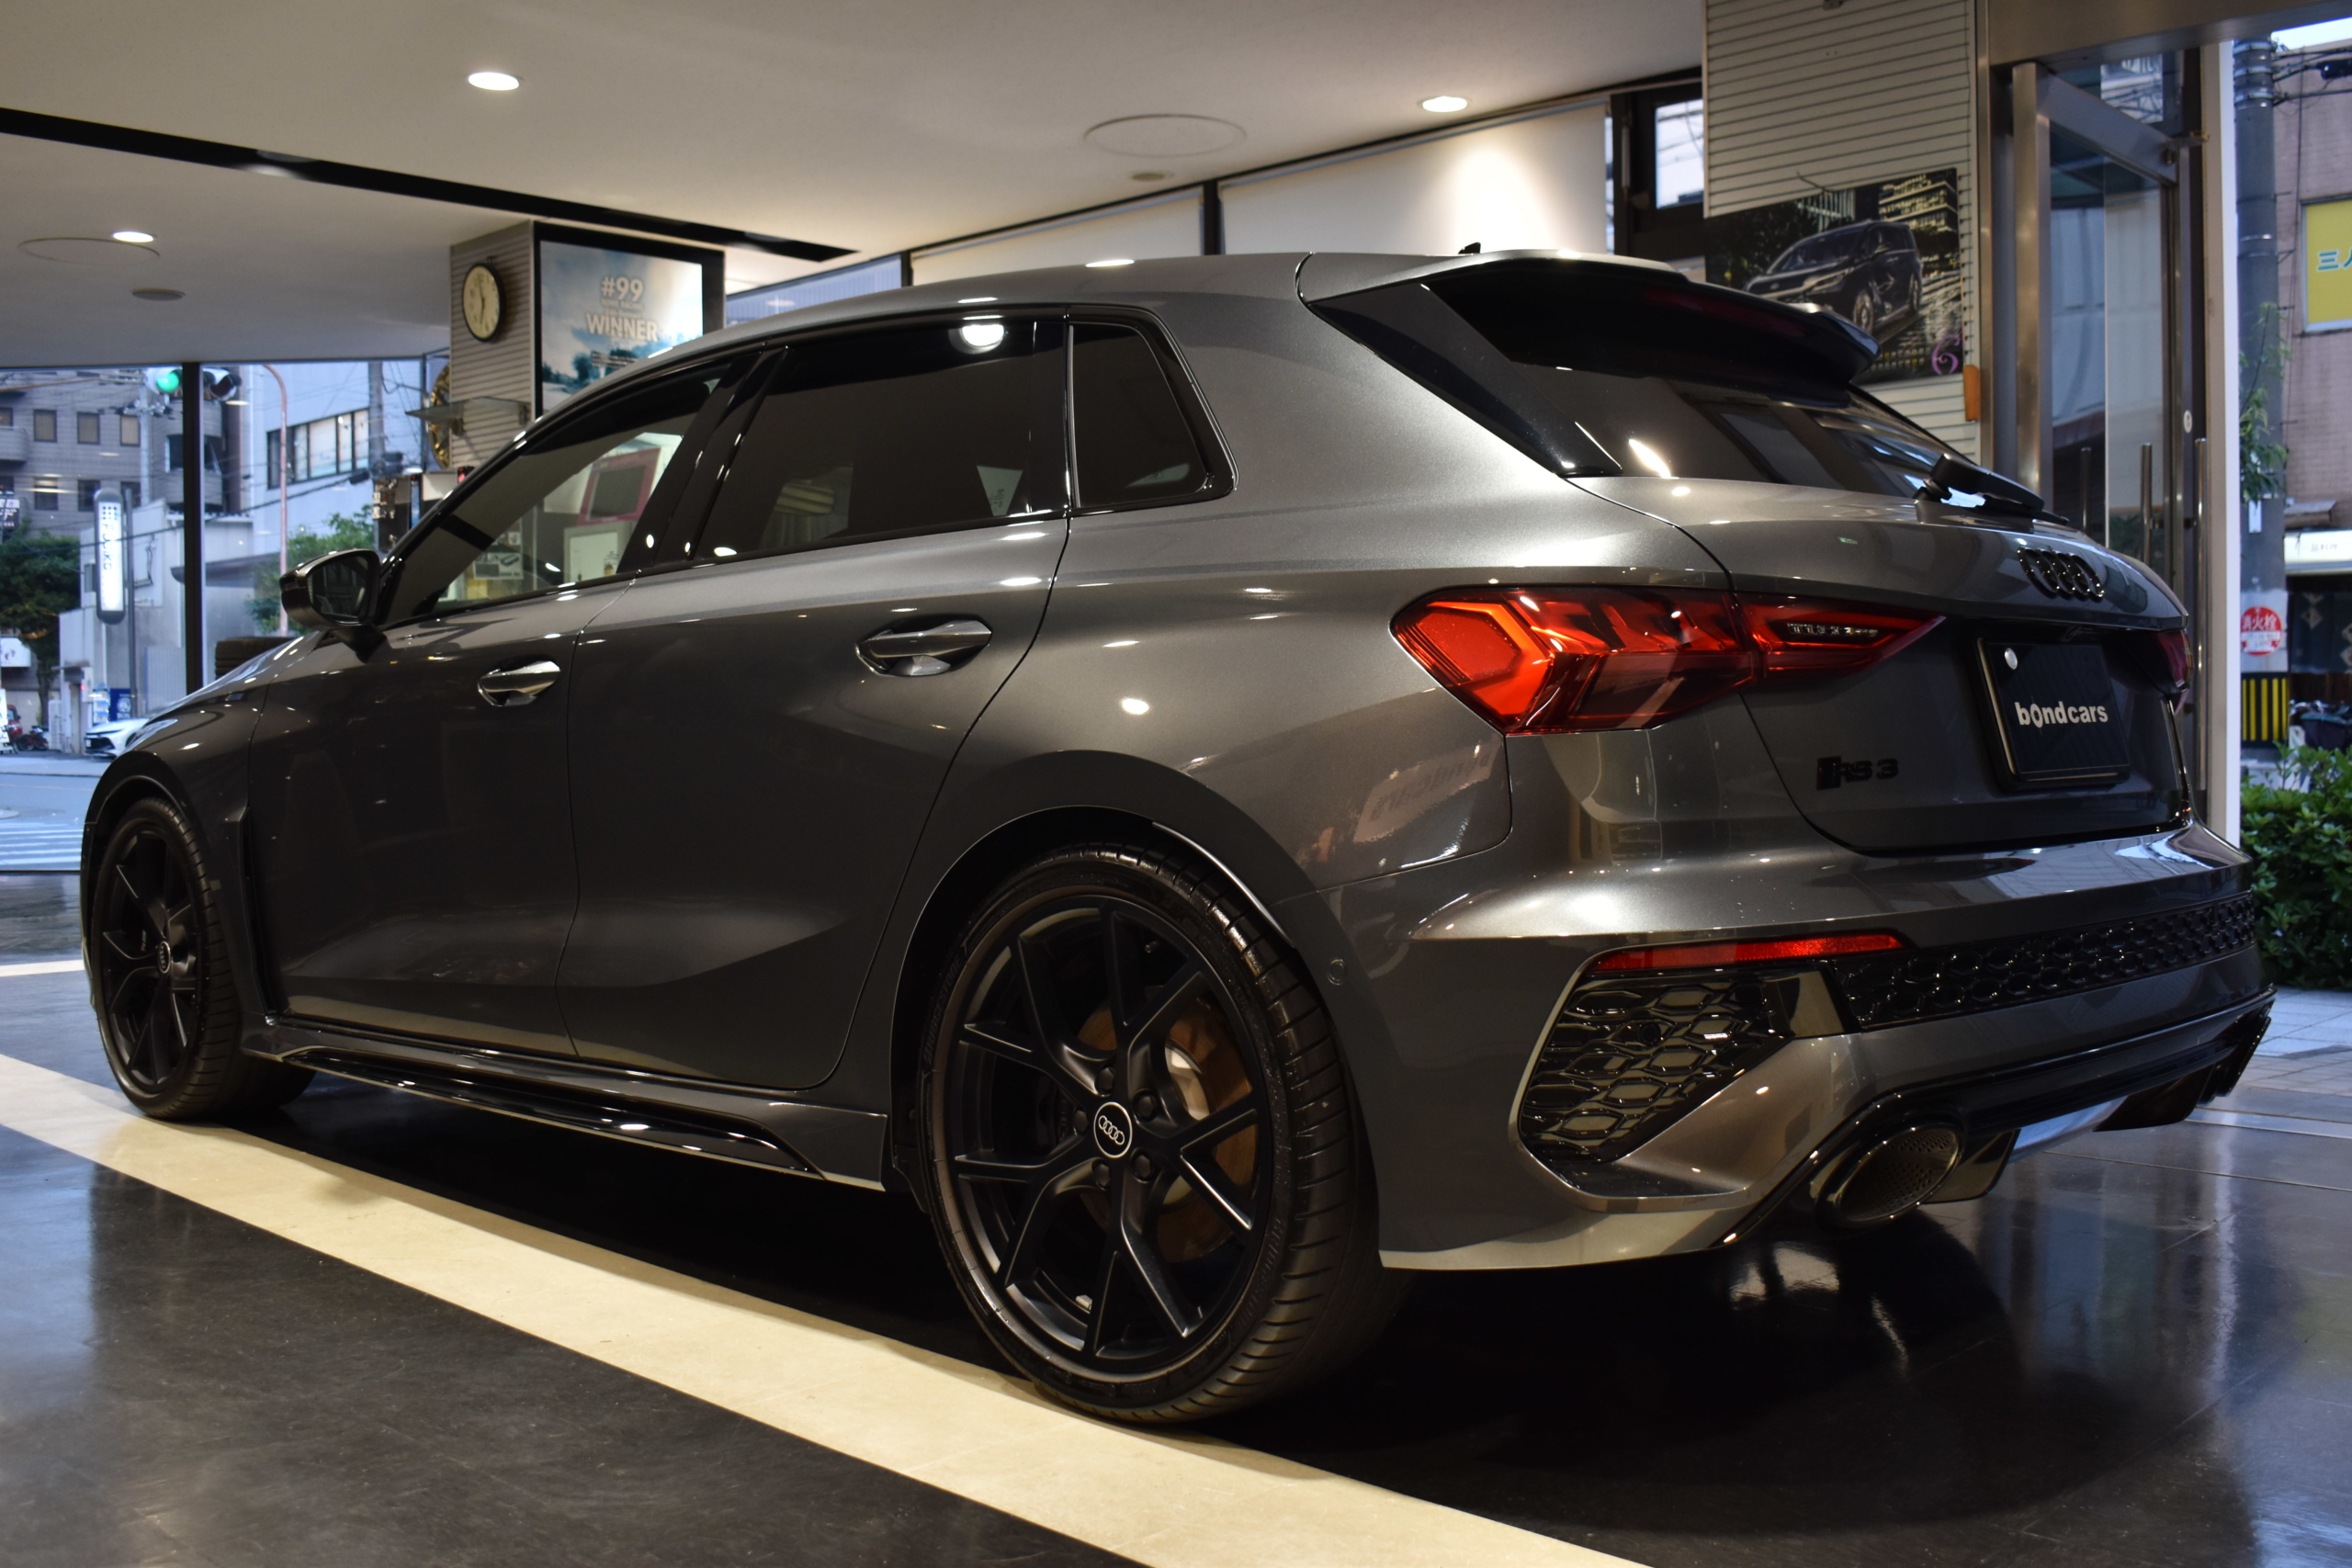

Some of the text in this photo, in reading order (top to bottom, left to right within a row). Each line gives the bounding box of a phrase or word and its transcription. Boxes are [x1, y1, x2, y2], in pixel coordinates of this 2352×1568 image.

[602, 276, 643, 301] #99
[585, 313, 658, 343] WINNER
[2242, 614, 2278, 631] 消火栓
[2014, 701, 2109, 728] bondcars
[1876, 759, 1898, 780] 3
[923, 953, 964, 1066] BRIDGESTONE
